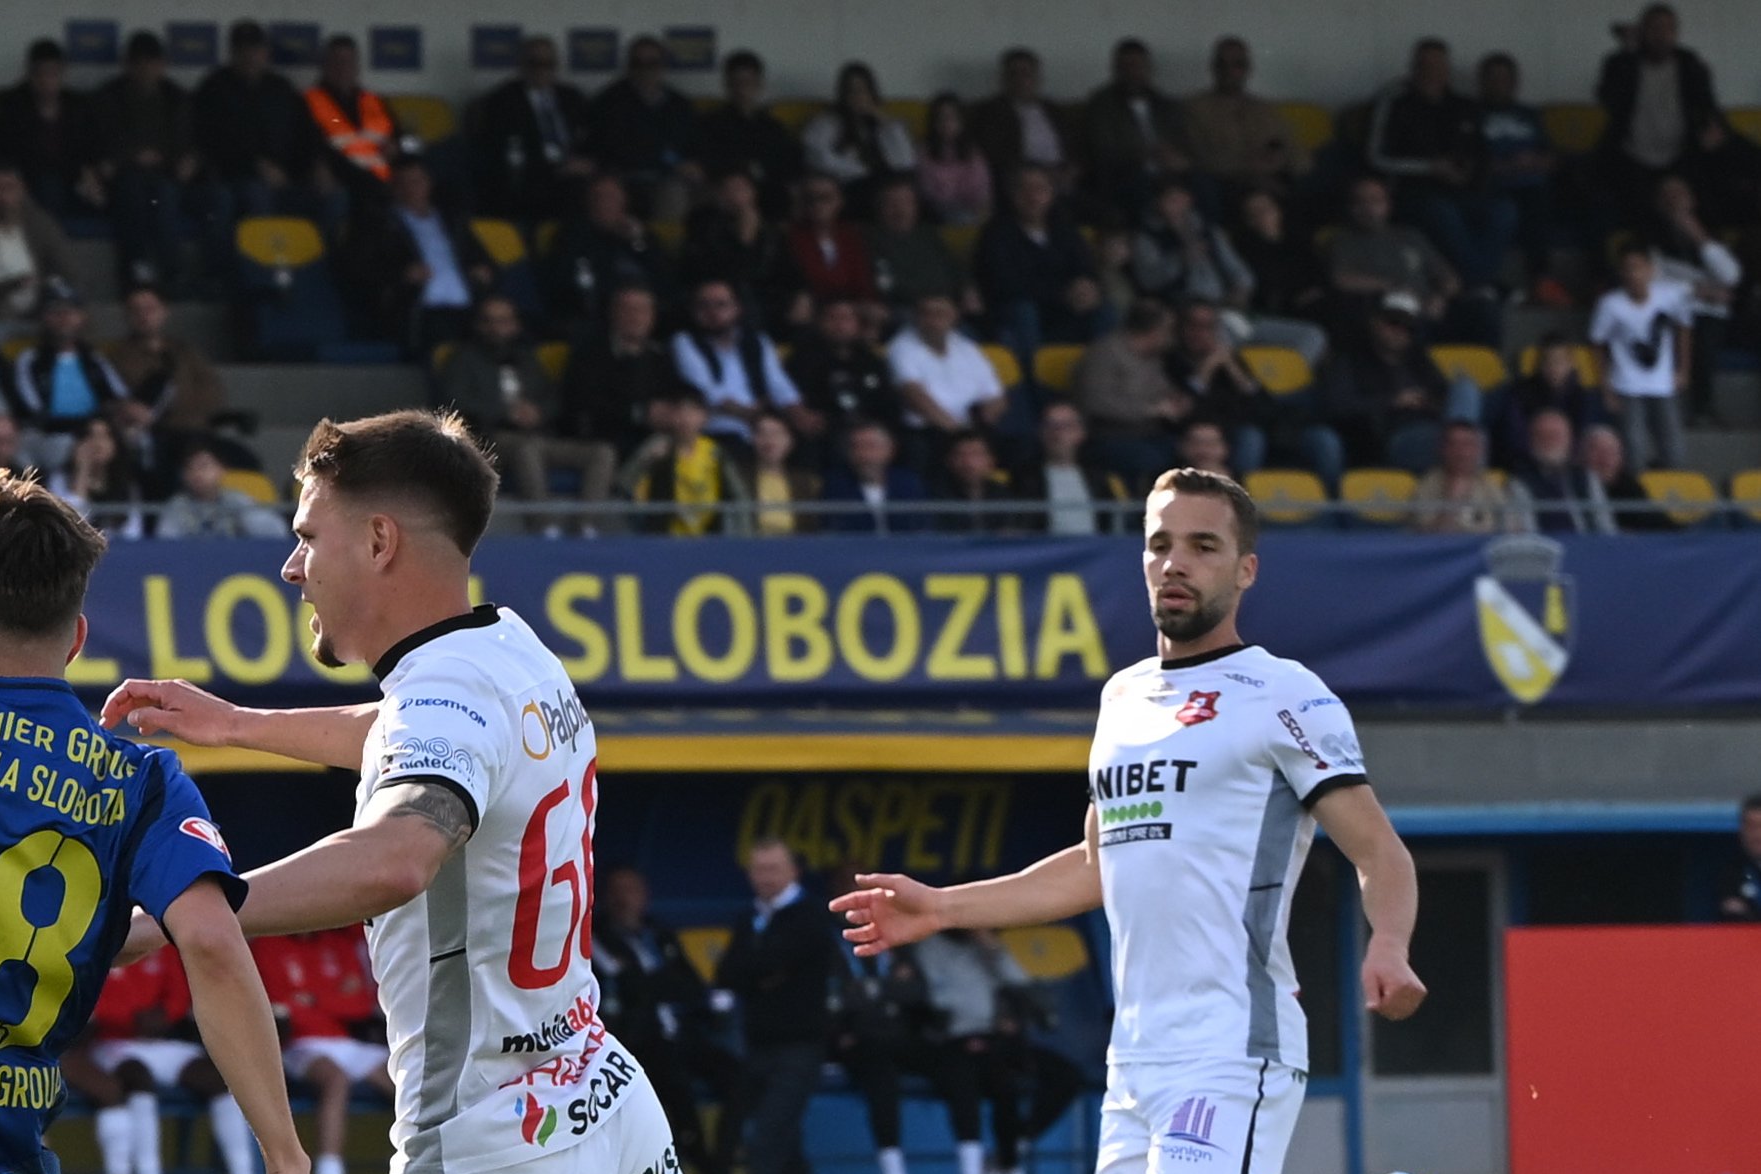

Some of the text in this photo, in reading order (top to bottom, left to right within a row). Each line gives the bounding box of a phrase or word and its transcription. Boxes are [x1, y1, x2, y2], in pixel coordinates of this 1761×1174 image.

[546, 572, 1109, 682] SLOBOZIA
[414, 697, 487, 729] DECATHLON
[1089, 759, 1198, 801] NIBET
[567, 1050, 637, 1136] SOCAR
